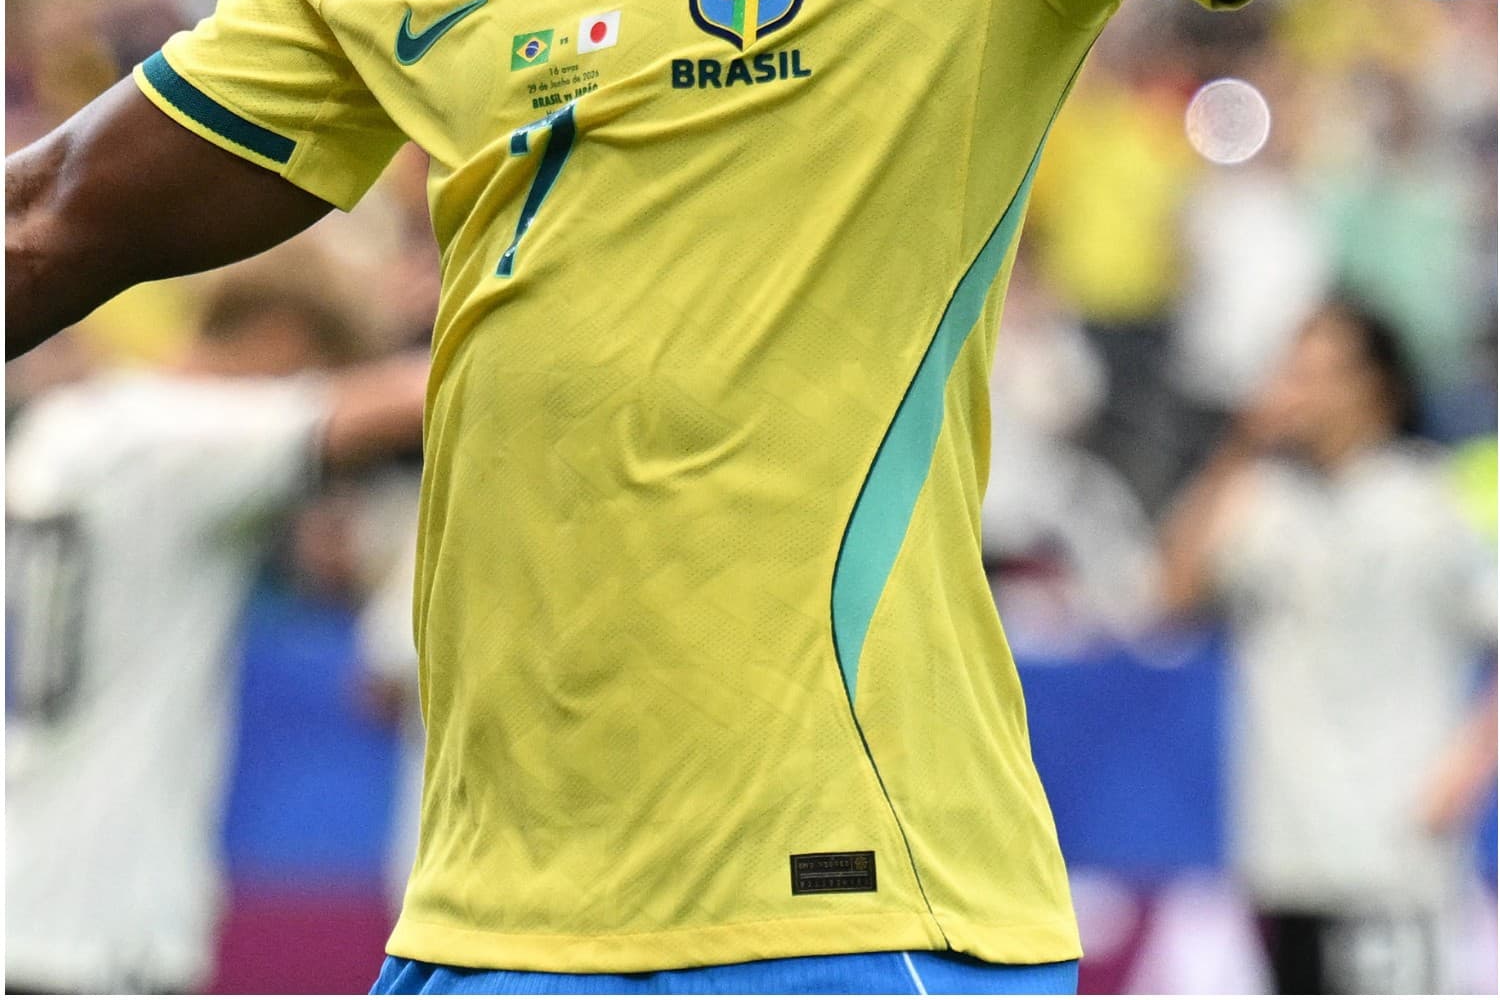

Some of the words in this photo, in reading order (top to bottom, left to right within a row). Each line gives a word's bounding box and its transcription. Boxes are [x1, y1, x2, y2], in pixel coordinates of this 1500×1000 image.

[671, 49, 812, 90] BRASIL
[532, 93, 562, 109] BRASIL
[495, 102, 577, 277] 7
